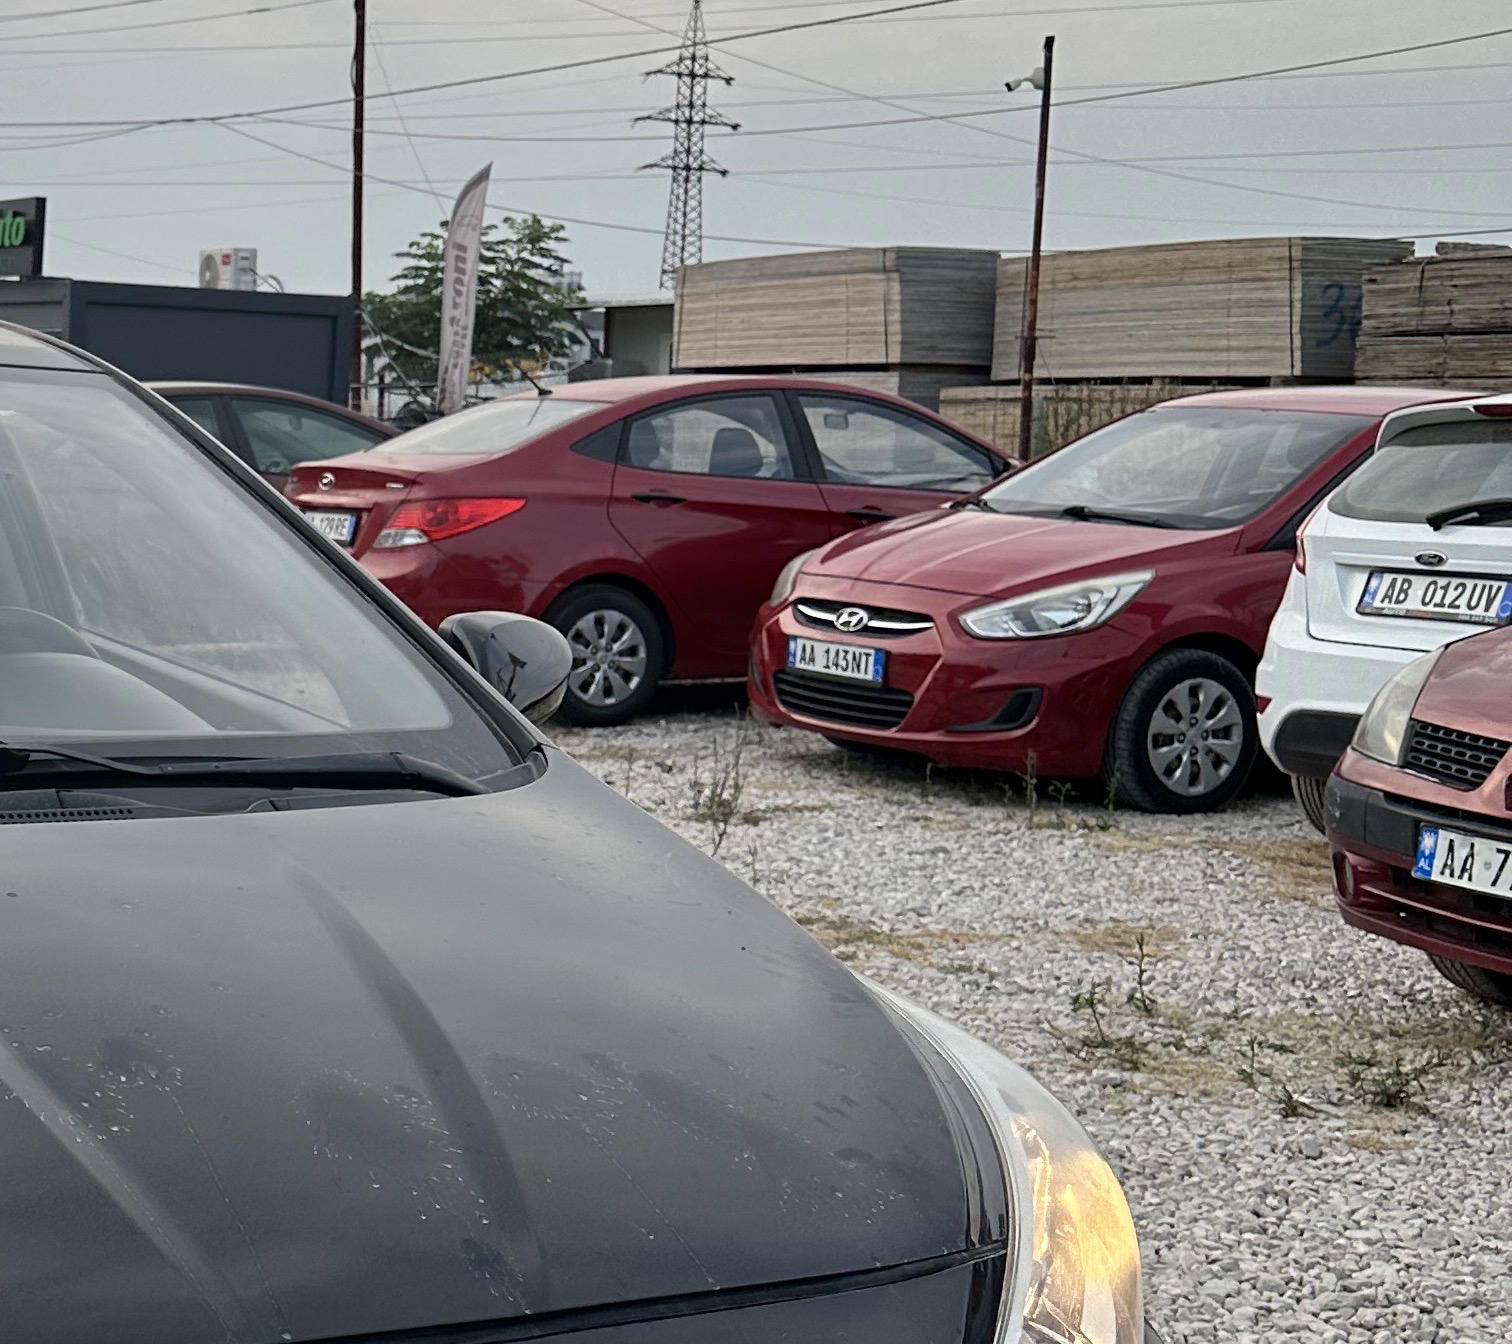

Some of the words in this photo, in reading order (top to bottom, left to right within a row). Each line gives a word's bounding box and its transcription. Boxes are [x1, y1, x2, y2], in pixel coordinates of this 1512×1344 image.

[1380, 577, 1412, 605] AB
[1421, 580, 1502, 613] 012UV
[799, 643, 815, 666] AA
[823, 648, 872, 675] 143NT
[1418, 857, 1431, 871] AL
[1440, 839, 1474, 882] AA
